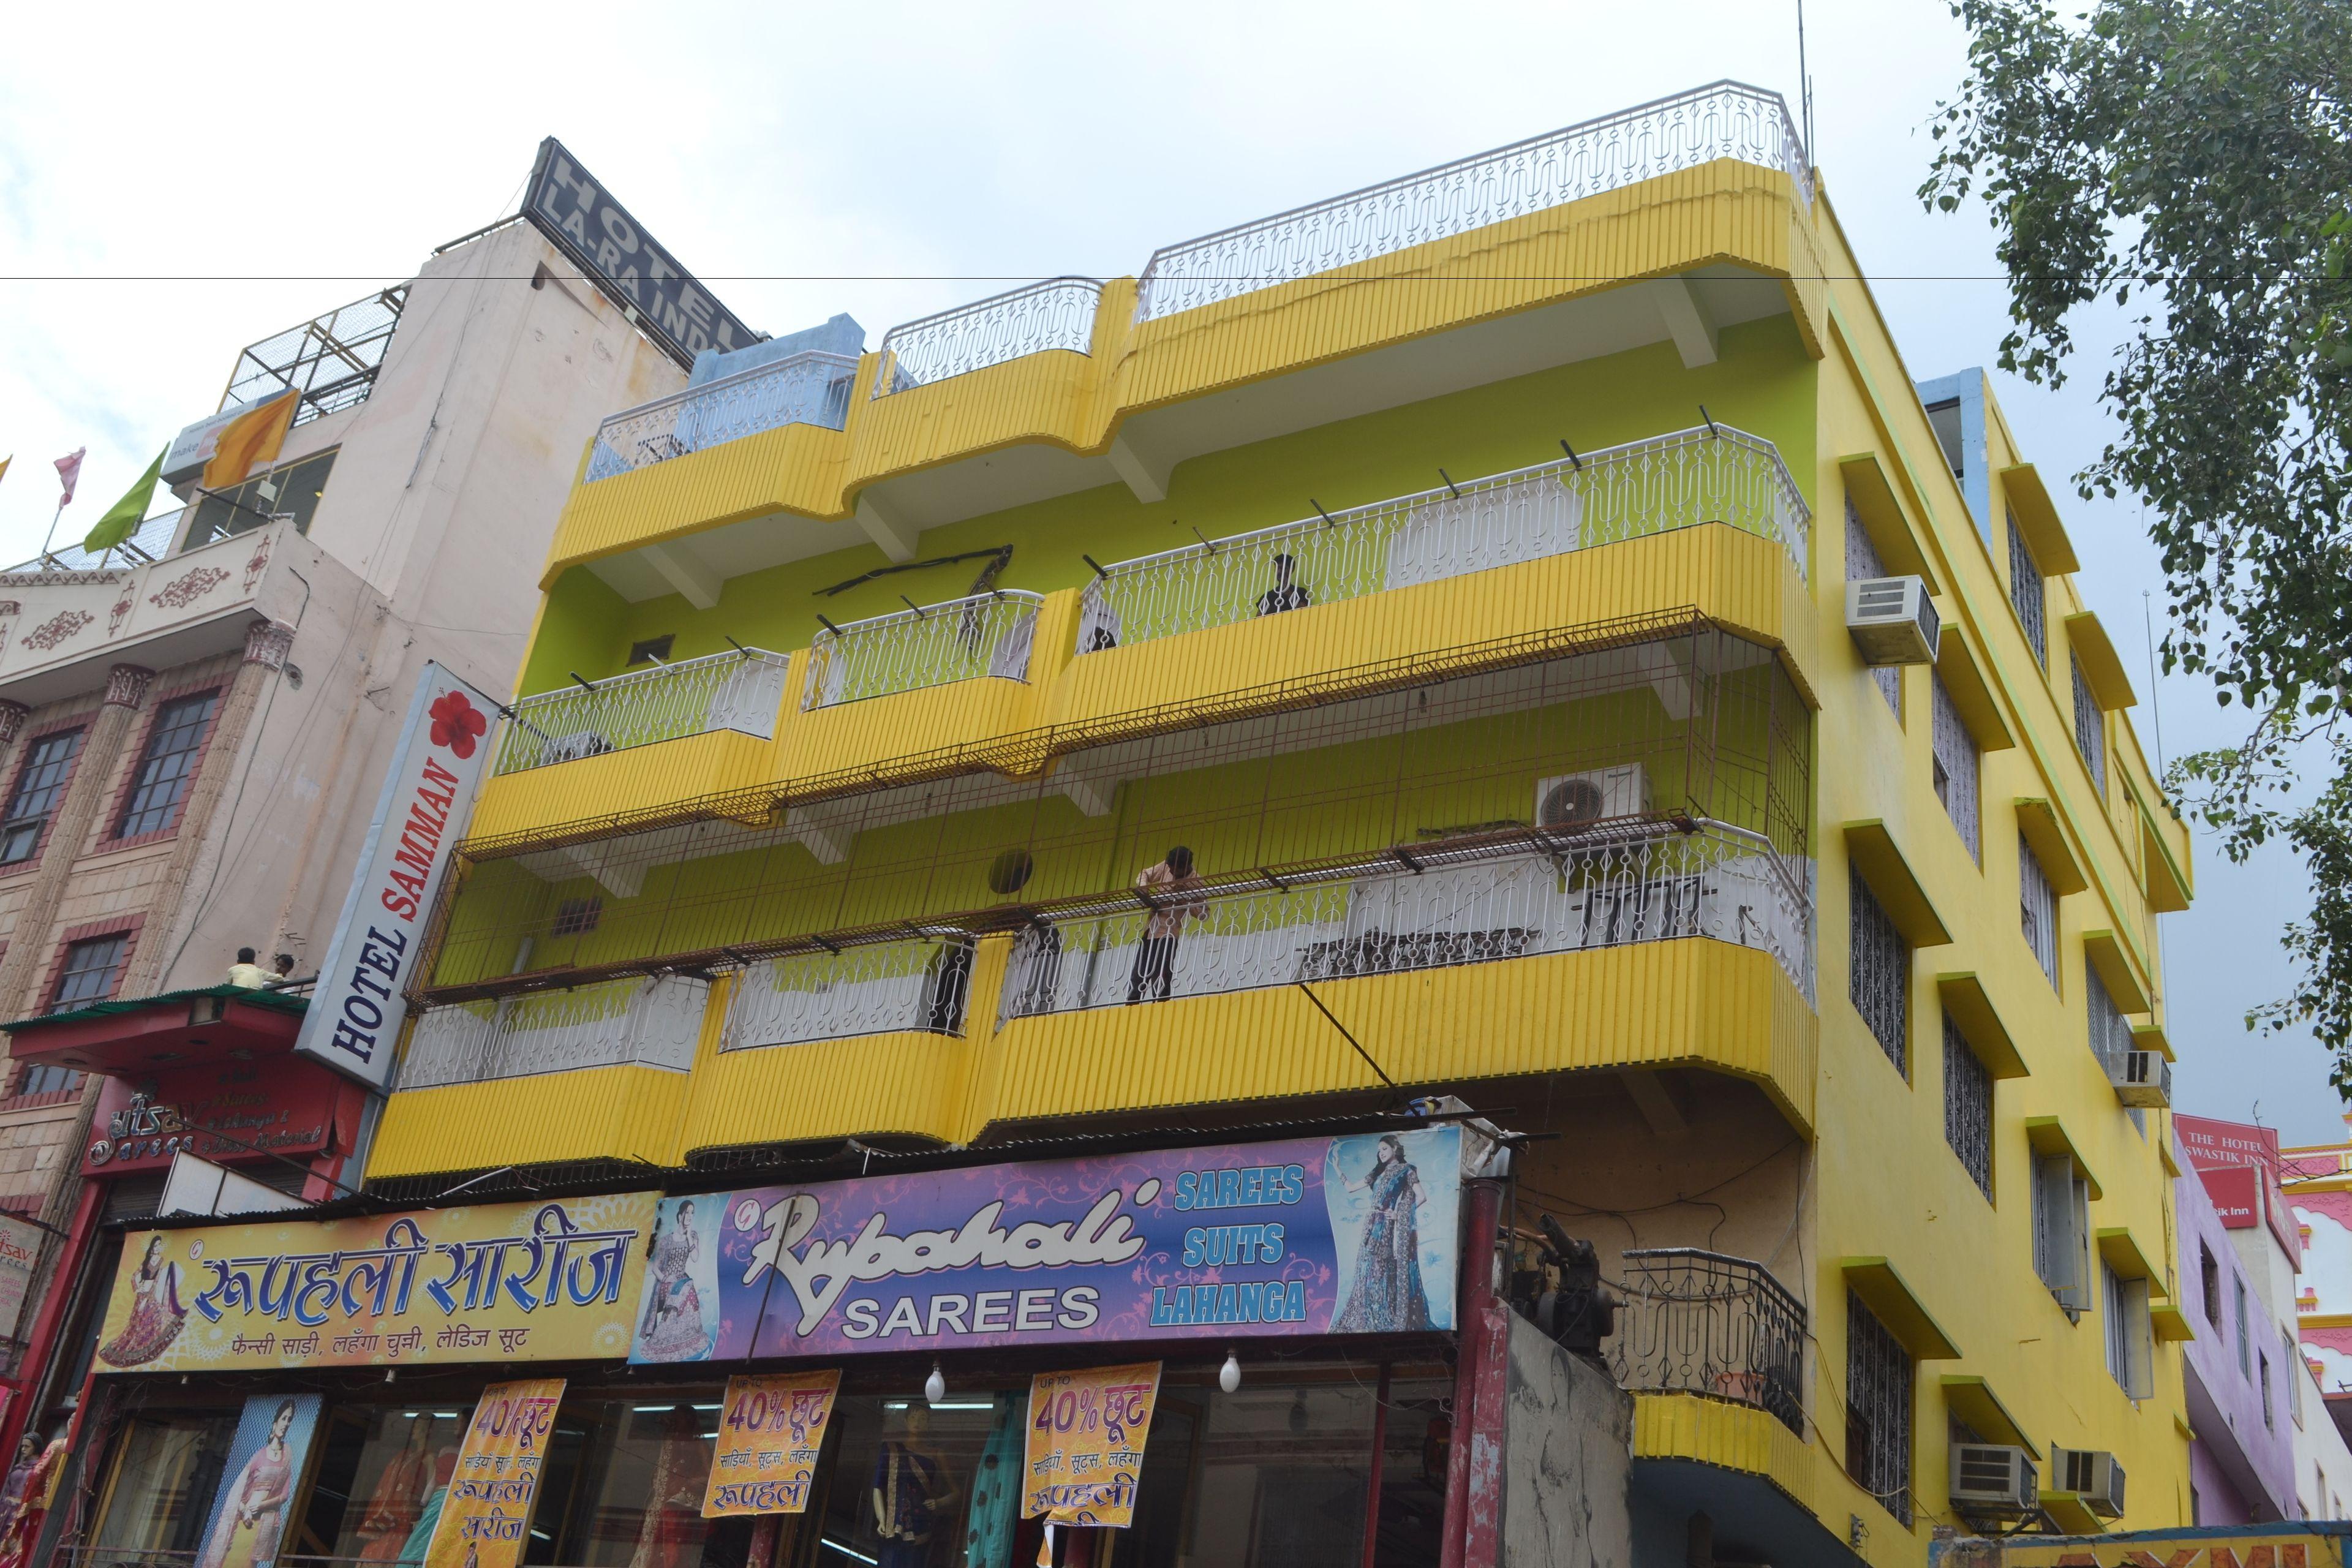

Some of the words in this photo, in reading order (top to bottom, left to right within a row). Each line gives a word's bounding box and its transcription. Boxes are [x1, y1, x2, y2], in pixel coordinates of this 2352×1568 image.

[543, 183, 639, 301] LA-RA
[651, 290, 720, 358] IND
[554, 156, 737, 352] HOTEL
[331, 925, 408, 1065] HOTEL
[381, 756, 459, 922] SAMMAN
[2185, 1146, 2241, 1163] SWASTIK
[2244, 1155, 2269, 1167] INN
[2188, 1132, 2214, 1145] THE
[2222, 1137, 2264, 1153] HOTEL
[1174, 1163, 1305, 1212] SAREES
[2230, 1207, 2249, 1216] Inn
[0, 1238, 32, 1261] tsav
[194, 1216, 428, 1327] रूपहली
[426, 1203, 638, 1317] सारीज
[1182, 1222, 1286, 1268] SUITS
[840, 1285, 1101, 1340] SAREES
[1149, 1279, 1307, 1328] LAHANGA
[437, 1323, 491, 1348] लेडिज
[499, 1328, 530, 1352] सूट
[736, 1379, 748, 1388] UP
[751, 1379, 763, 1388] TO
[1040, 1378, 1054, 1388] UP
[1057, 1376, 1071, 1386] TO
[726, 1389, 788, 1432] 40%
[789, 1388, 833, 1444] छूट
[1035, 1387, 1101, 1435] 40%
[1102, 1383, 1152, 1444] छूट
[712, 1470, 812, 1510] रूपहली
